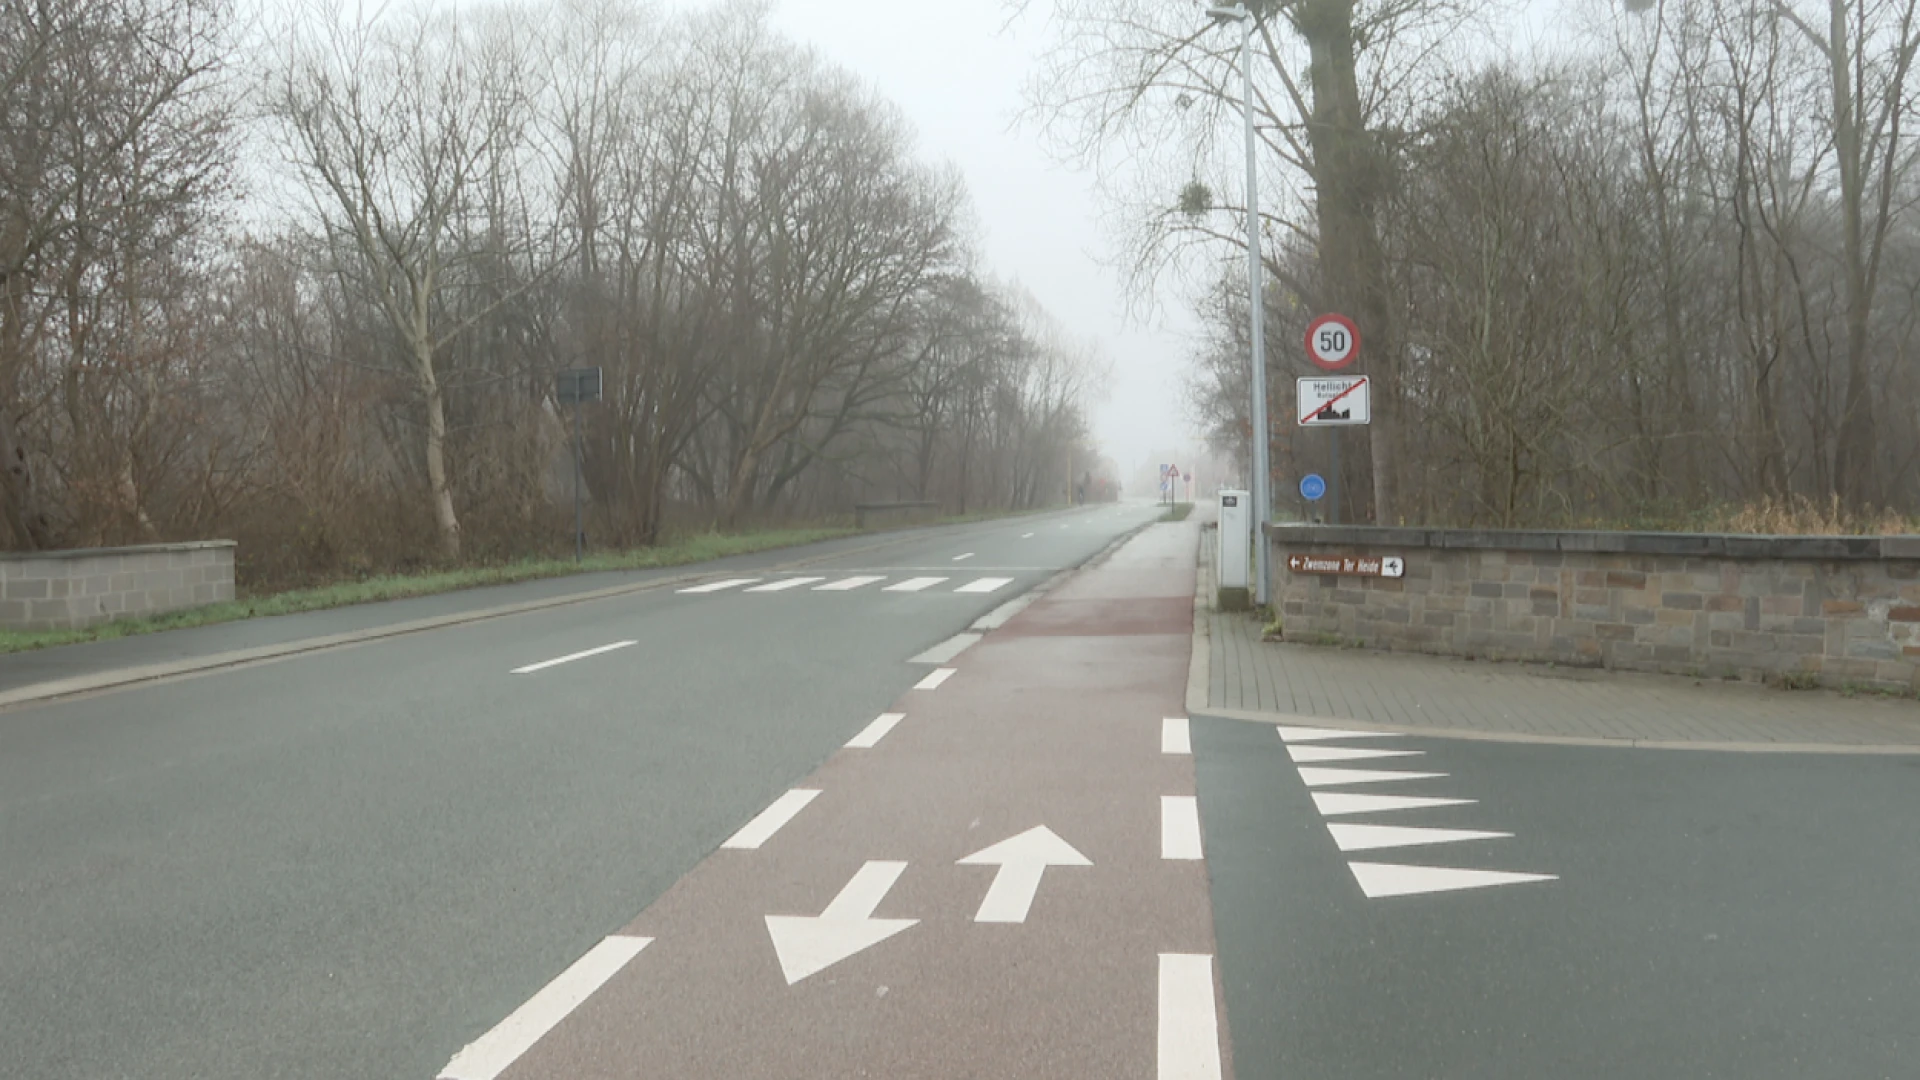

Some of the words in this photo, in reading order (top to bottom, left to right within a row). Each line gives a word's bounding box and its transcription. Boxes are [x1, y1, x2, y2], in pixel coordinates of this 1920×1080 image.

[1320, 331, 1345, 352] 50
[1303, 556, 1340, 571] Zwemzone
[1344, 558, 1355, 572] Ter
[1357, 558, 1379, 573] Heide
